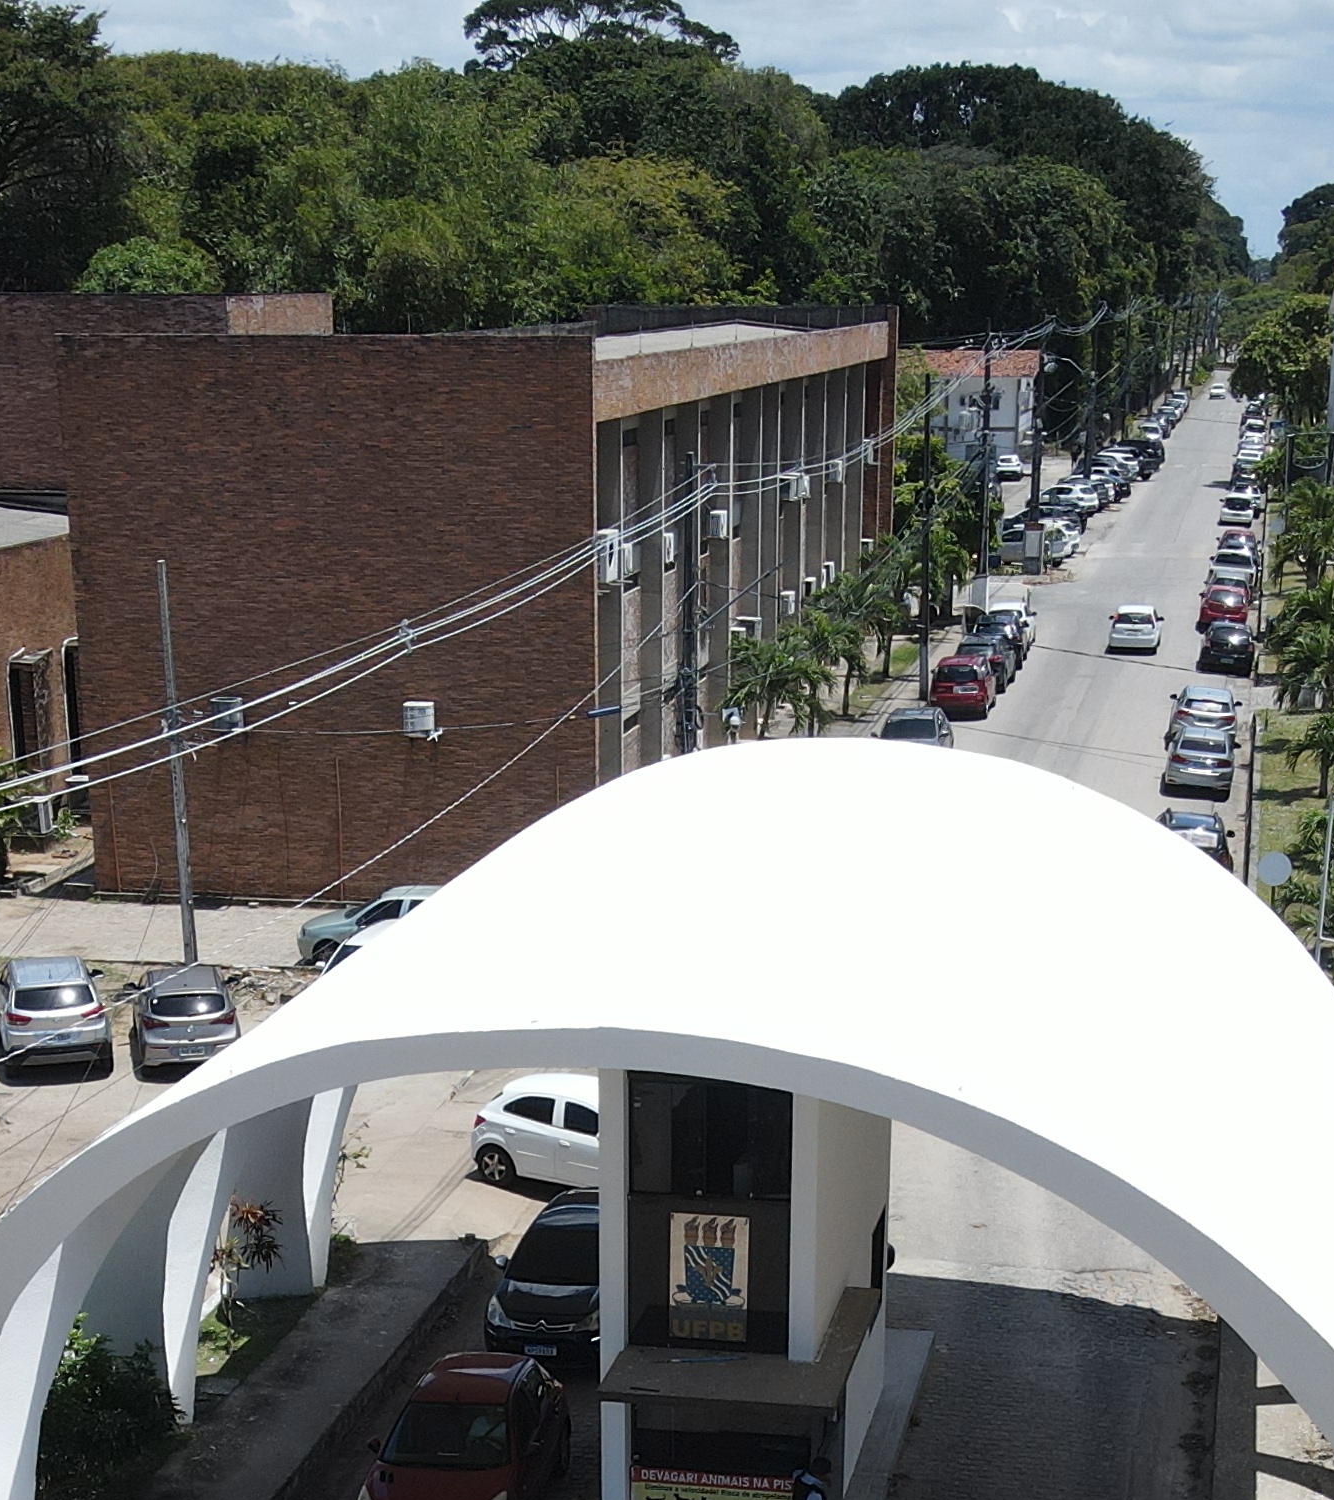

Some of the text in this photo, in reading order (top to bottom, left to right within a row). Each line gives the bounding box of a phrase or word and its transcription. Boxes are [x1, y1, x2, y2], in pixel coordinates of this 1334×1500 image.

[672, 1319, 744, 1341] UFPB
[641, 1469, 697, 1484] DEVAGAR!
[701, 1474, 750, 1487] ANIMAIS
[753, 1478, 769, 1488] NA
